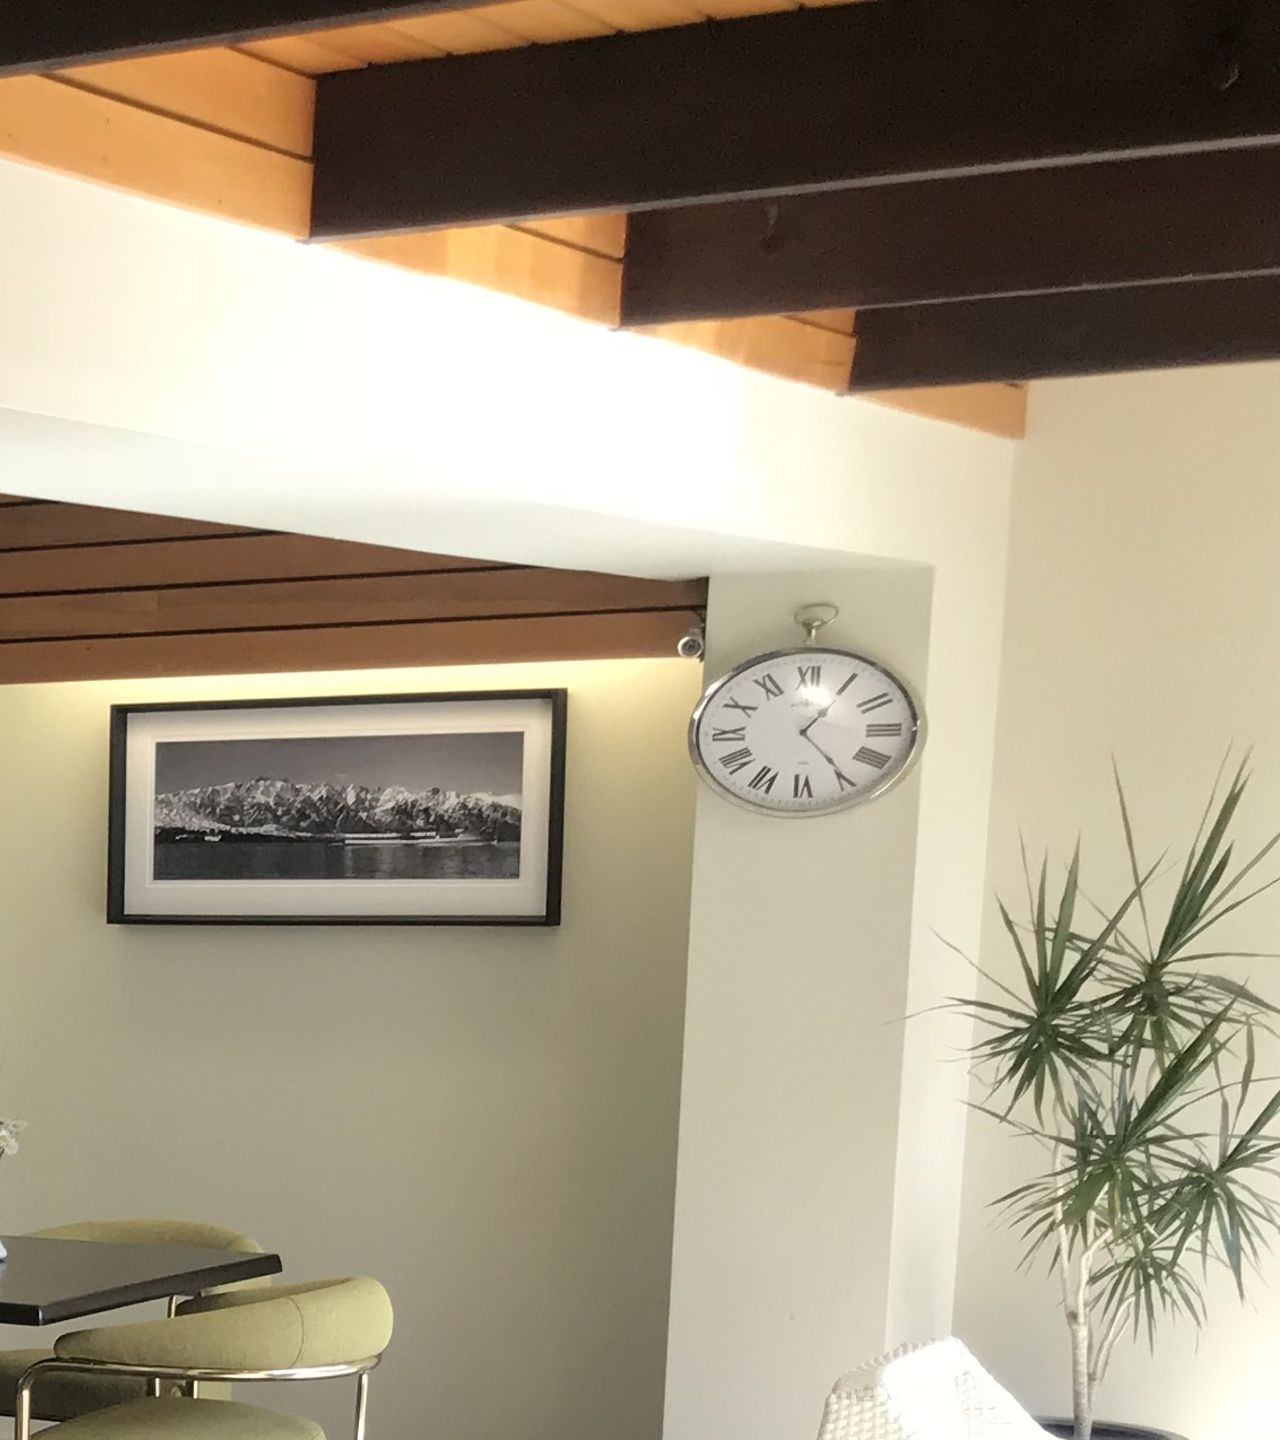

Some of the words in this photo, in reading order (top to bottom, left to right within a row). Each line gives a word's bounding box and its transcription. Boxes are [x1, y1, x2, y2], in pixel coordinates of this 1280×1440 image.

[753, 673, 785, 700] XI
[797, 665, 822, 691] XII
[722, 696, 759, 718] X
[856, 692, 893, 715] II
[712, 726, 747, 742] IX
[866, 723, 902, 738] III
[718, 747, 756, 776] VIII
[793, 773, 814, 799] VI
[833, 768, 858, 792] V
